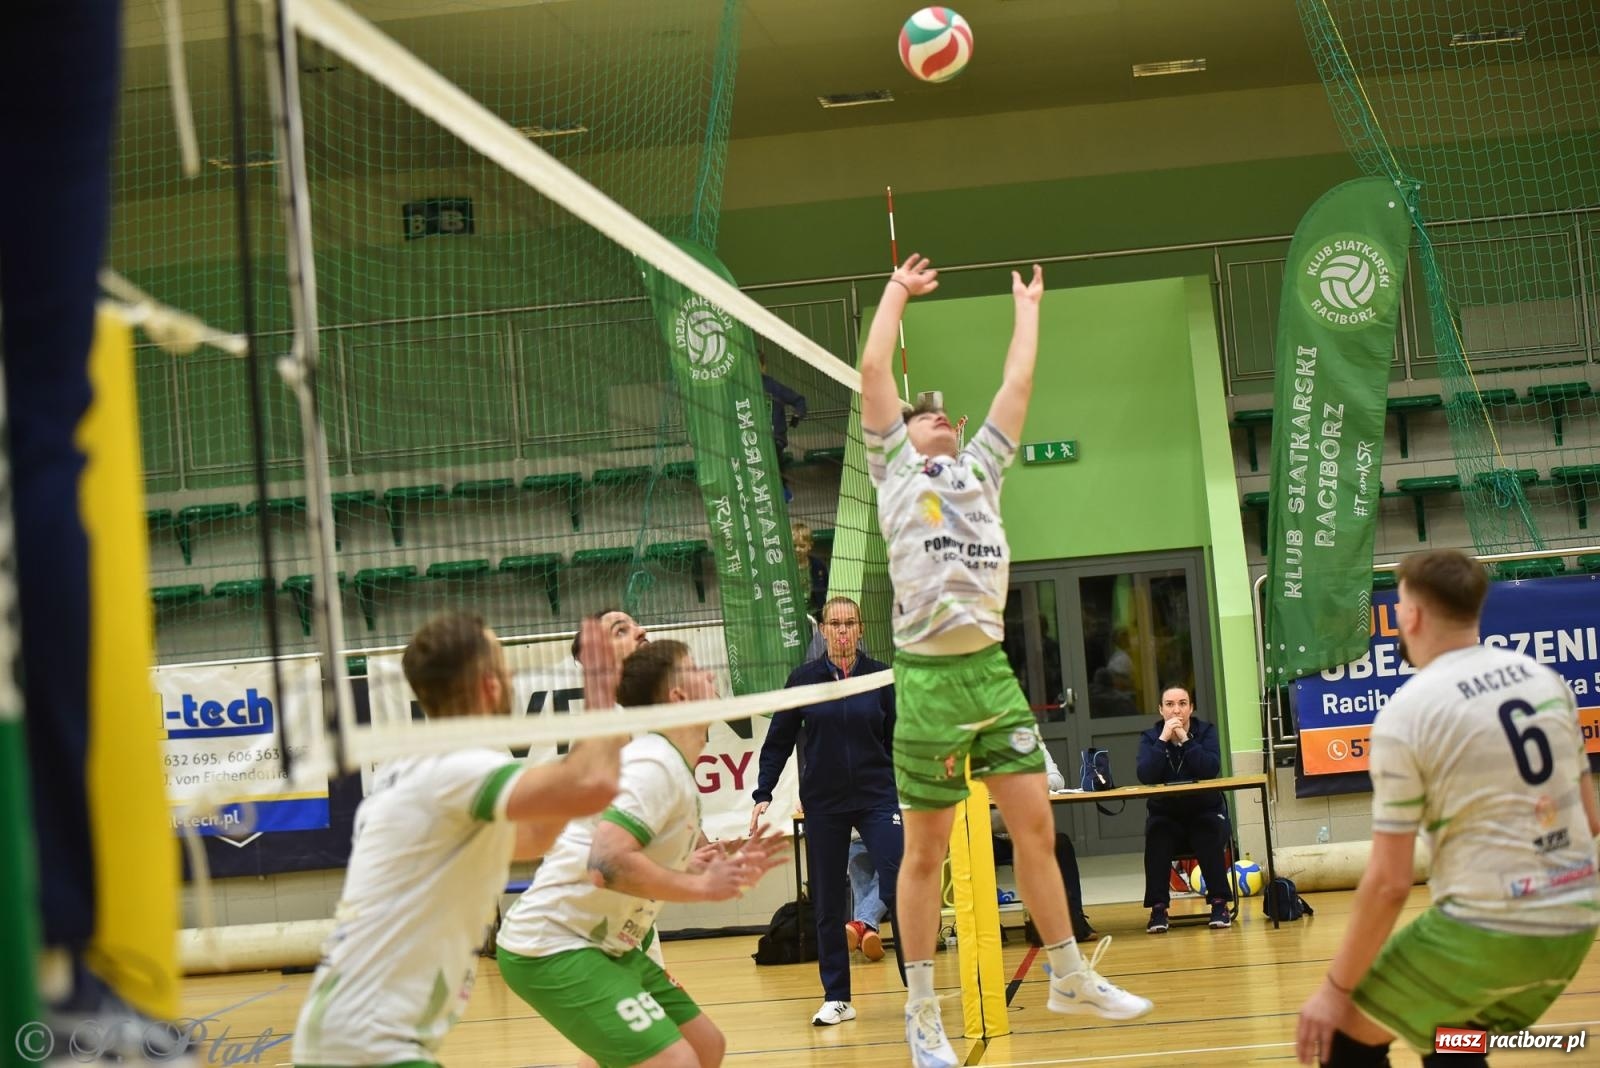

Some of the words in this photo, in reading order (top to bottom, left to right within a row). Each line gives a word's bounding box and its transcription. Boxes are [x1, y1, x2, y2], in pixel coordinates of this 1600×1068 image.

[1306, 245, 1333, 276] KLUB
[1334, 240, 1390, 288] SIATKARSKI
[1311, 298, 1376, 325] RACIBÓRZ
[1288, 345, 1317, 514] SIATKARSKI
[1314, 402, 1344, 547] RACIBÓRZ
[1353, 440, 1375, 517] #TeamKSR
[1284, 529, 1304, 599] KLUB
[1322, 688, 1400, 716] Racib
[1457, 664, 1534, 700] RACZEK
[164, 753, 189, 768] 632
[228, 750, 252, 762] 606
[255, 748, 280, 761] 363
[1350, 738, 1371, 758] 5
[1498, 698, 1554, 787] 6
[175, 773, 200, 786] von
[694, 751, 754, 794] GY
